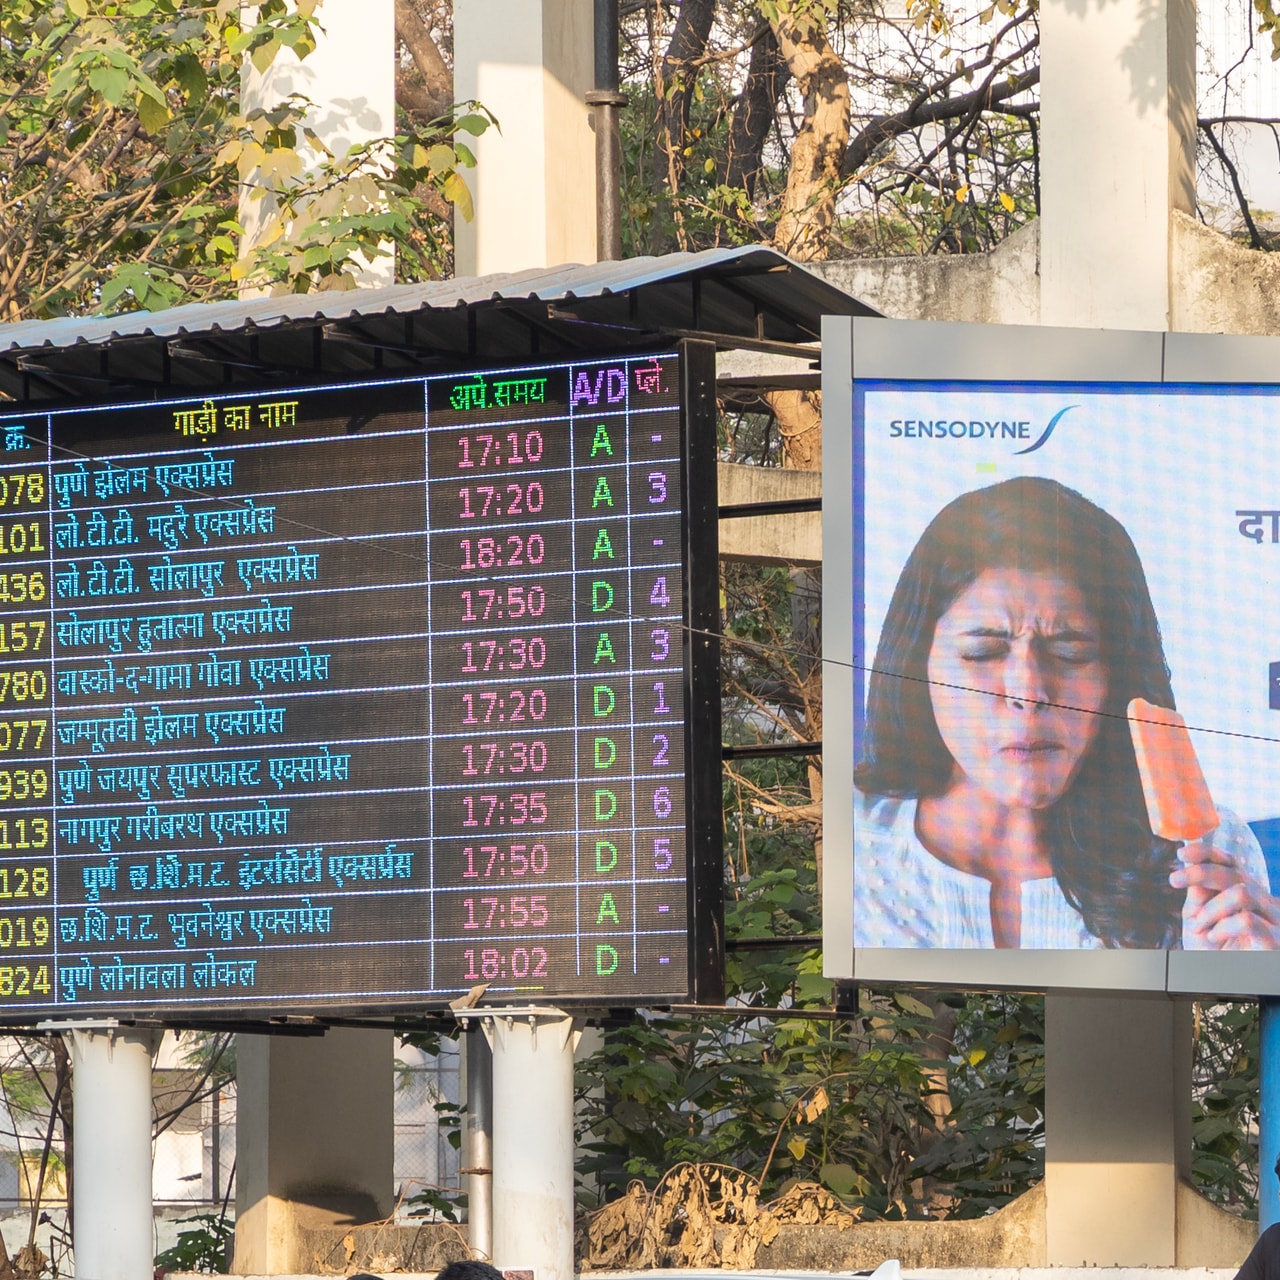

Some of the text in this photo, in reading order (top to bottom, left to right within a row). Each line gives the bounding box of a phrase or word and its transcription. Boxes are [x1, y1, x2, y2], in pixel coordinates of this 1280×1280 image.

[570, 369, 626, 406] A/D
[223, 405, 250, 431] का
[258, 401, 298, 428] नाम
[889, 419, 1030, 440] SENSODYNE
[458, 430, 544, 468] 17:10
[590, 424, 613, 457] A
[54, 452, 235, 507] पुणे झेलम एक्सप्रेस
[458, 472, 667, 518] 17:20 A 3
[193, 499, 276, 544] एक्सप्रेस
[459, 534, 545, 569] 18:20
[592, 529, 615, 559] A
[148, 556, 225, 597] सोलापुर
[237, 546, 319, 591] एक्सप्रेस
[461, 577, 670, 621] 17:50 D 4
[56, 598, 293, 653] सोलापुर हुतात्मा एक्सप्रेस
[197, 653, 241, 687] गोवा
[249, 646, 331, 690] एक्सप्रेस
[461, 629, 670, 672] 17:30 A 3
[143, 706, 199, 745] झेलम
[205, 700, 286, 744] एक्सप्रेस
[462, 682, 670, 724] 17:20 D 1
[58, 746, 351, 803] पुणे जयपुर सुपरफास्ट एक्सप्रेस
[462, 734, 670, 776] 17:30 D 2
[58, 800, 290, 851] नागपुर गरीबरथ एक्सप्रेस
[462, 786, 671, 827] 17:35 D 6
[462, 838, 672, 878] 17:50 D 5
[249, 899, 333, 941] एक्सप्रेस
[463, 896, 549, 929] 17:55
[596, 893, 620, 924] A
[0, 965, 51, 996] 824
[59, 952, 257, 1001] पुणे लोनावला लोकल
[463, 947, 548, 980] 18:02
[596, 945, 618, 975] D
